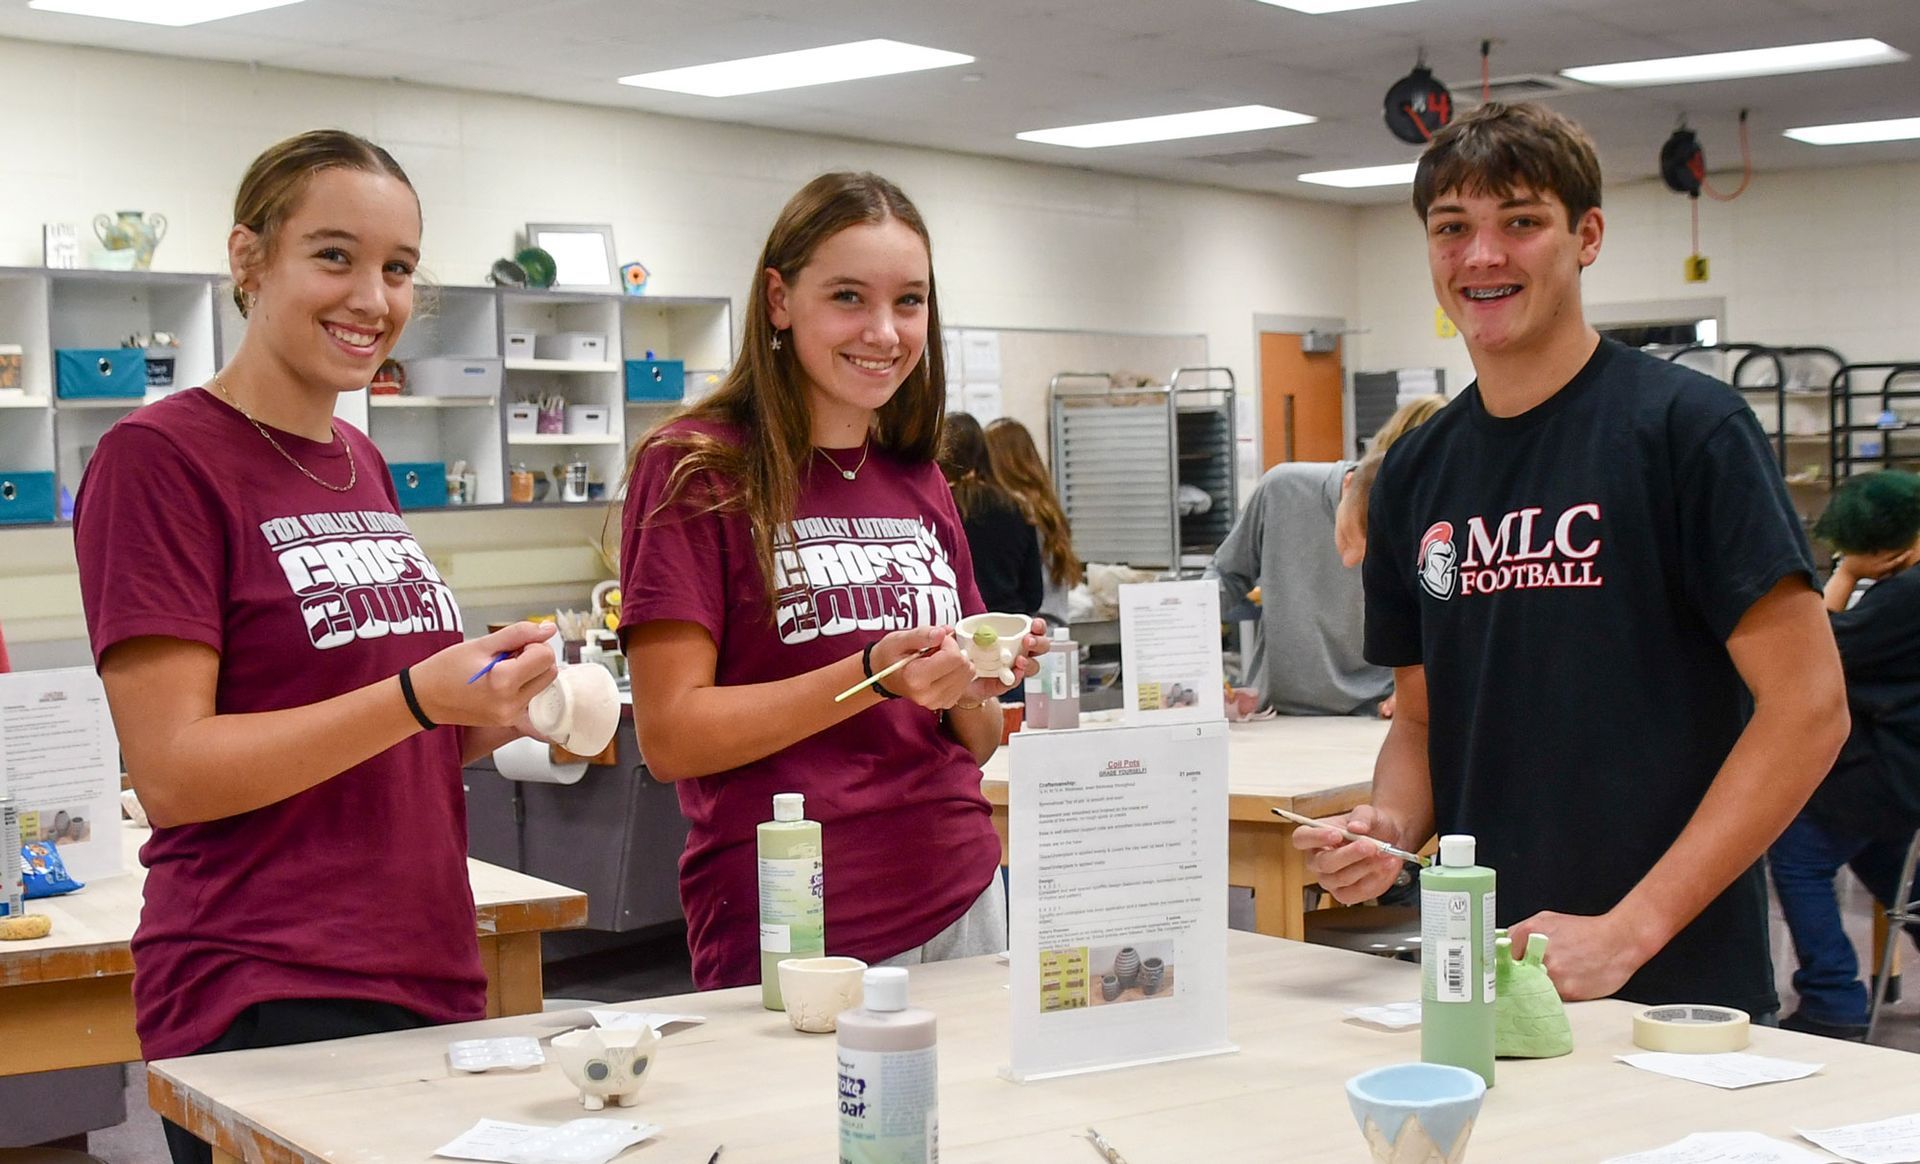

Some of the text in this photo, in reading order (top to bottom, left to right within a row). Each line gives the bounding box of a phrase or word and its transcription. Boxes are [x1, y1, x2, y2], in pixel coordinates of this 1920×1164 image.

[259, 516, 309, 546] FOX
[303, 511, 367, 537] VALLEY
[793, 517, 853, 540] VALLEY
[1461, 503, 1600, 568] MLC
[278, 538, 441, 597] CROSS
[774, 543, 932, 594] CROSS
[1461, 562, 1602, 595] FOOTBALL
[1196, 727, 1202, 736] 3
[1107, 759, 1140, 770] Coil Pots
[838, 1100, 866, 1118] oat
